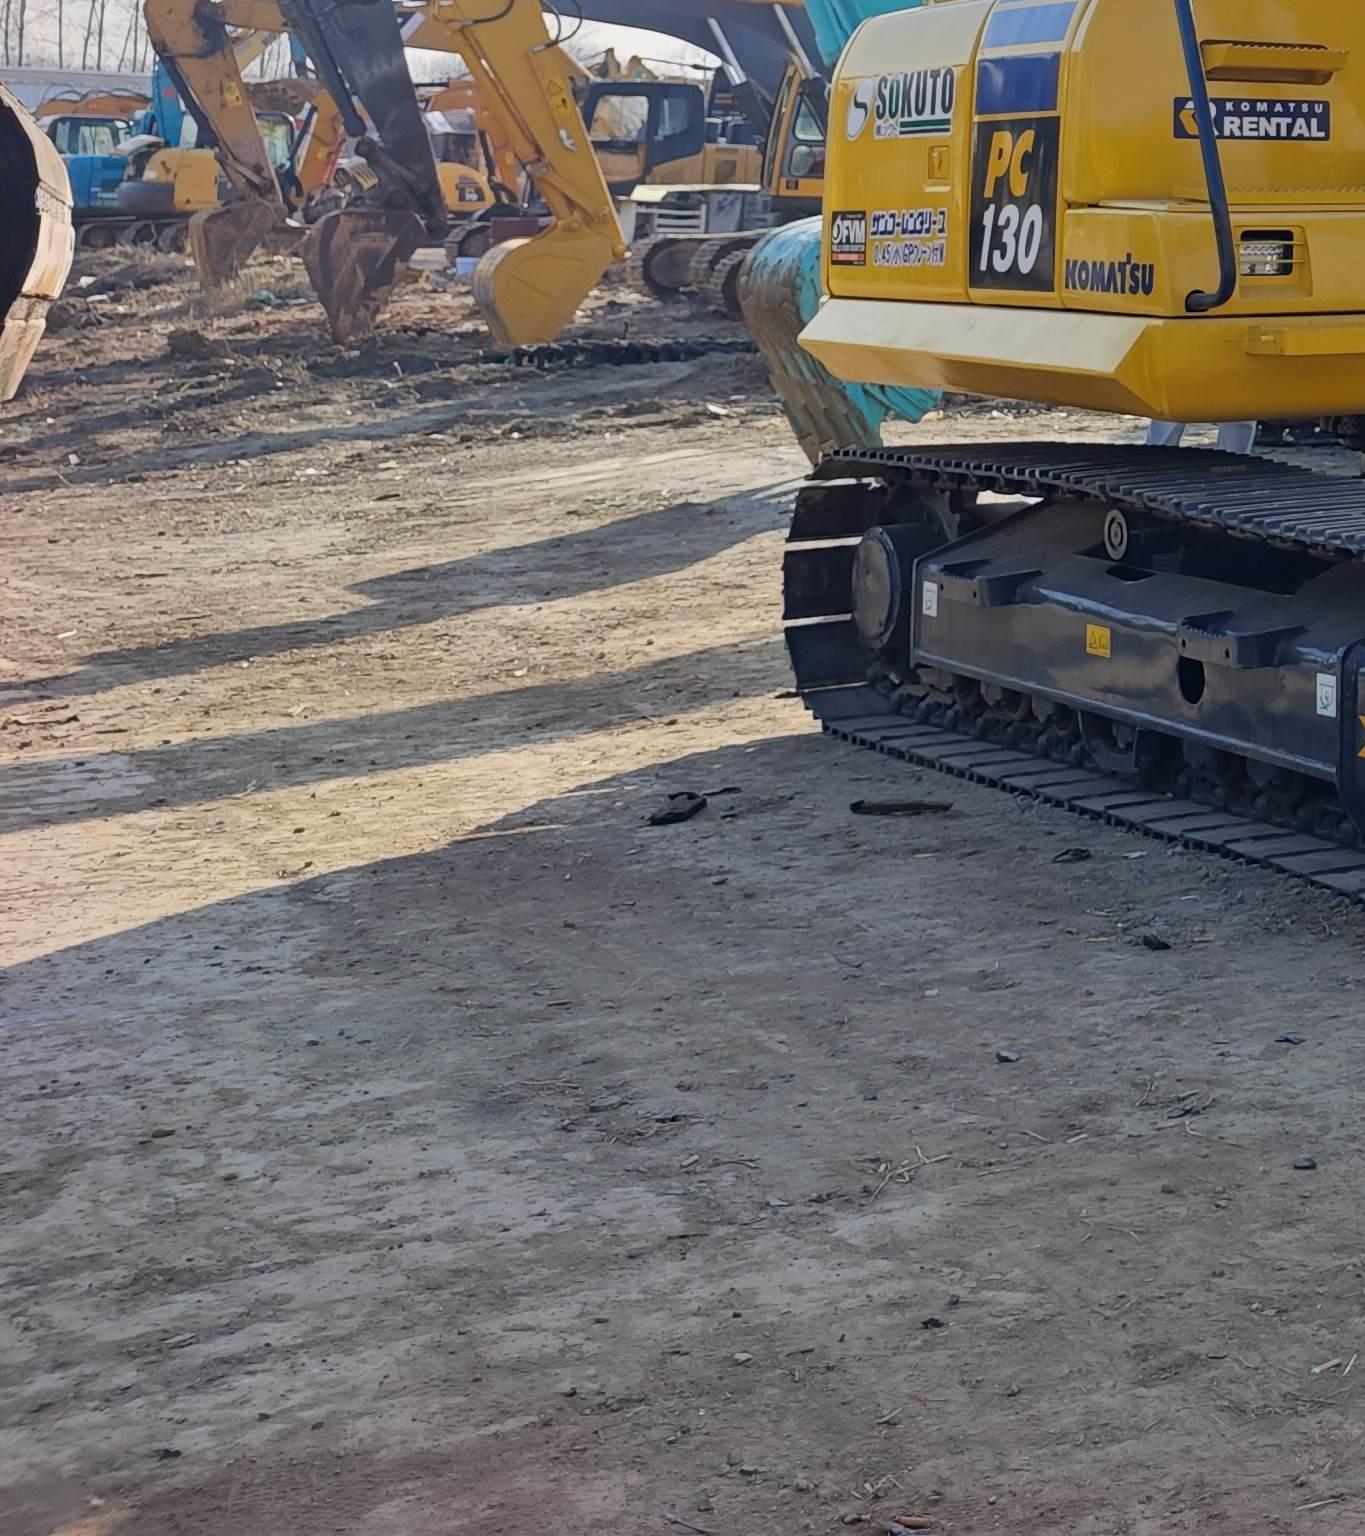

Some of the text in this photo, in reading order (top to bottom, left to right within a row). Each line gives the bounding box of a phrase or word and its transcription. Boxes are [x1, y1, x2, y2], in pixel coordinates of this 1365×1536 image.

[876, 67, 955, 120] SOKUTO
[1225, 101, 1324, 114] KOMATSU
[1223, 116, 1326, 138] RENTAL
[983, 129, 1036, 199] PC
[979, 203, 1043, 275] 130
[1064, 253, 1155, 296] KOMATSU
